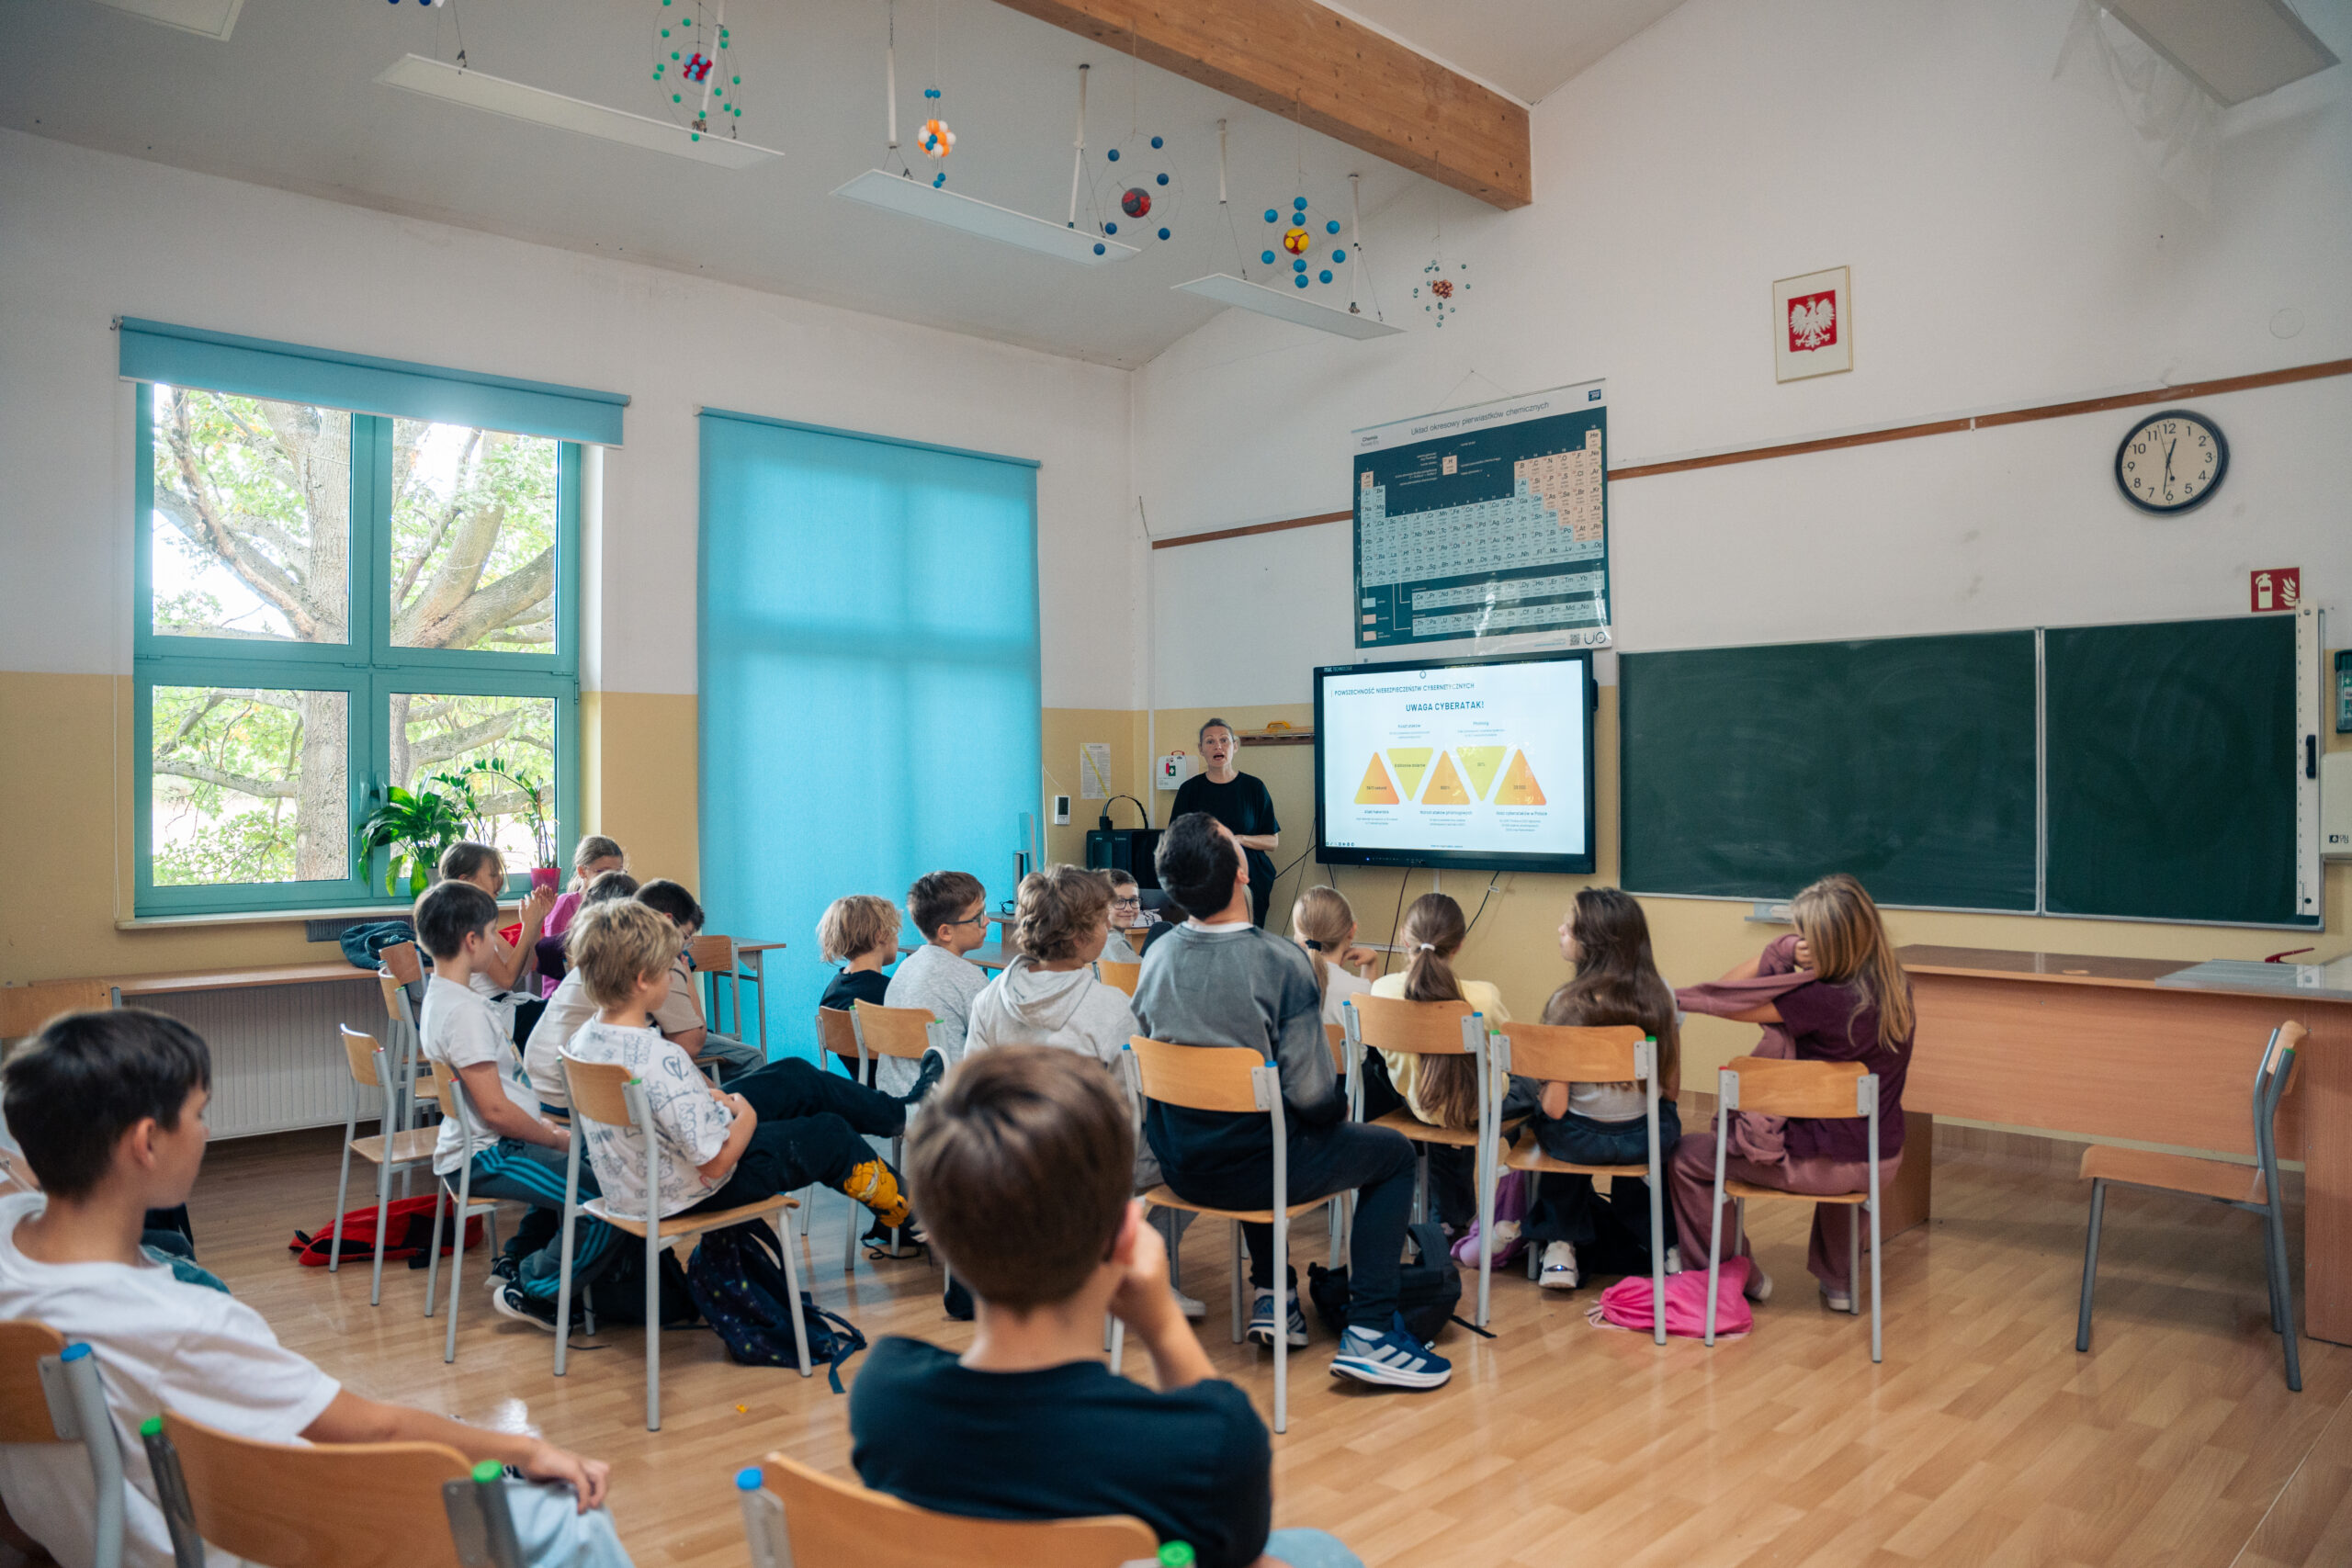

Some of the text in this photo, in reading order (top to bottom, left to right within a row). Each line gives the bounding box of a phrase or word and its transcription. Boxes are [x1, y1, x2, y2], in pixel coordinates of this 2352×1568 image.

[1411, 401, 1549, 434] Układ okresowy pierwiastków chemicznych
[2163, 423, 2176, 434] 12
[2187, 426, 2190, 436] 1
[2147, 431, 2157, 441] 11
[2199, 436, 2206, 446] 2
[2132, 444, 2145, 455] 10
[2205, 452, 2212, 463] 3
[2128, 461, 2135, 471] 9
[2199, 470, 2206, 480] 4
[2134, 478, 2141, 488] 8
[2185, 483, 2192, 493] 5
[2148, 488, 2154, 497] 7
[2166, 491, 2173, 501] 6
[1335, 687, 1374, 695] POWSZECHNOŚĆ
[1376, 683, 1421, 693] NIEBEZPIECZEŃSTW
[1435, 701, 1484, 710] CYBERATAK!
